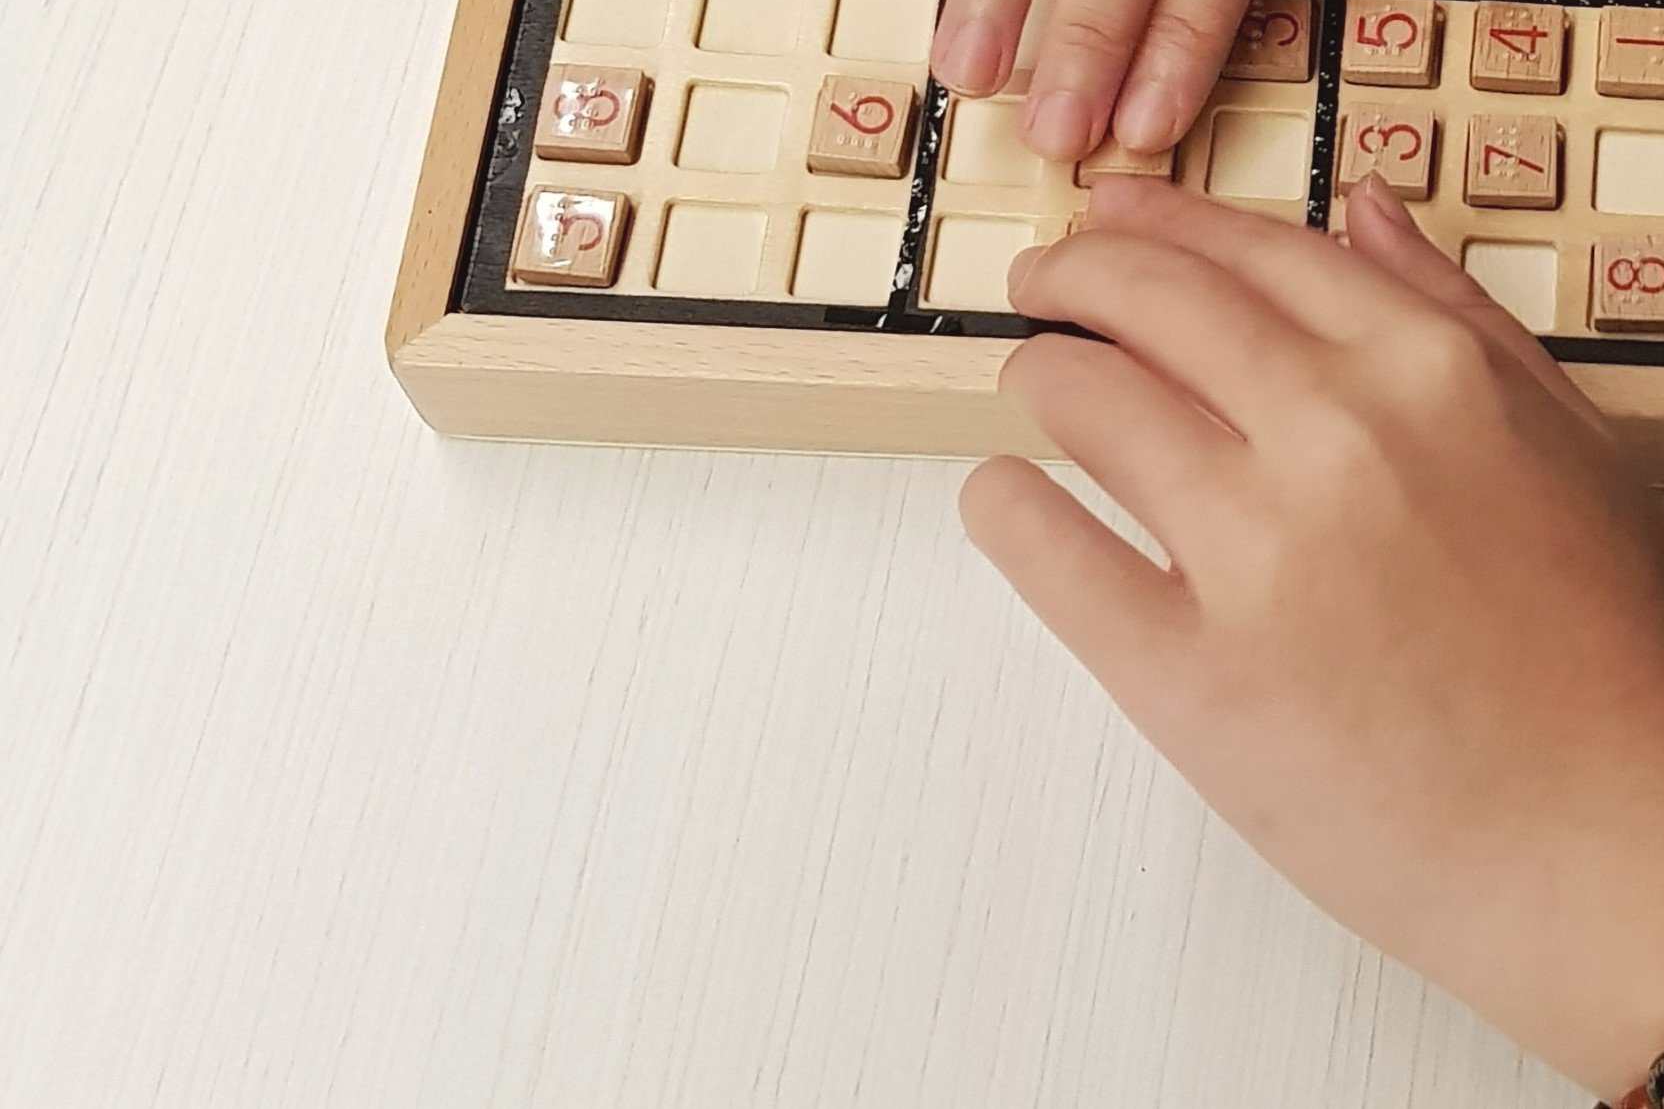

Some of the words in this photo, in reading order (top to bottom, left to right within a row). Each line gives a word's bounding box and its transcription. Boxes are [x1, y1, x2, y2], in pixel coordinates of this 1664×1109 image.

[1356, 12, 1418, 50] 5
[1488, 25, 1548, 61] 4
[552, 88, 621, 128] 8
[830, 96, 893, 134] 6
[1358, 124, 1422, 161] 3
[1483, 144, 1544, 175] 7
